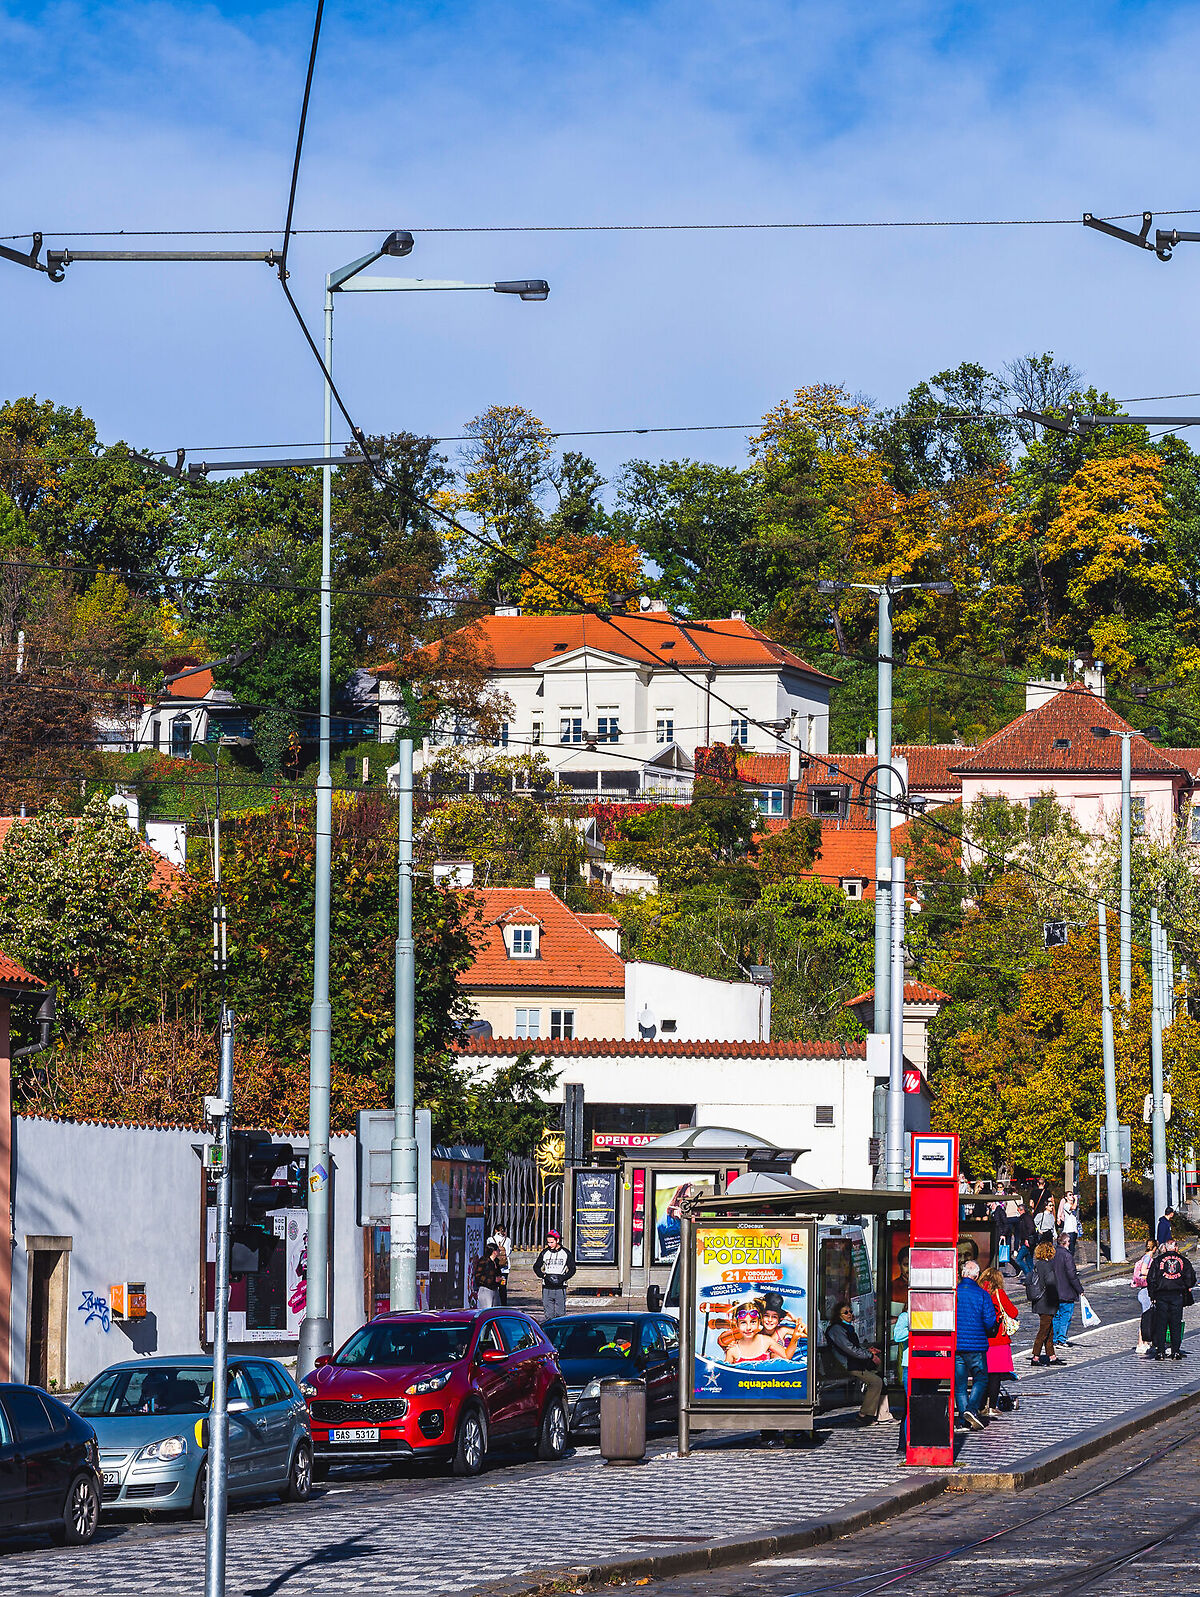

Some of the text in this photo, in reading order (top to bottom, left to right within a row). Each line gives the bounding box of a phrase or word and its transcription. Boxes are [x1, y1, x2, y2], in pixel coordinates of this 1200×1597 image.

[596, 1135, 629, 1145] OPEN
[704, 1233, 783, 1249] KOUZELNÝ
[704, 1249, 782, 1265] PODZIM
[726, 1271, 740, 1281] 21
[738, 1378, 802, 1389] aquapalace.cz
[335, 1429, 375, 1440] 5AS 5312
[104, 1473, 114, 1483] 92
